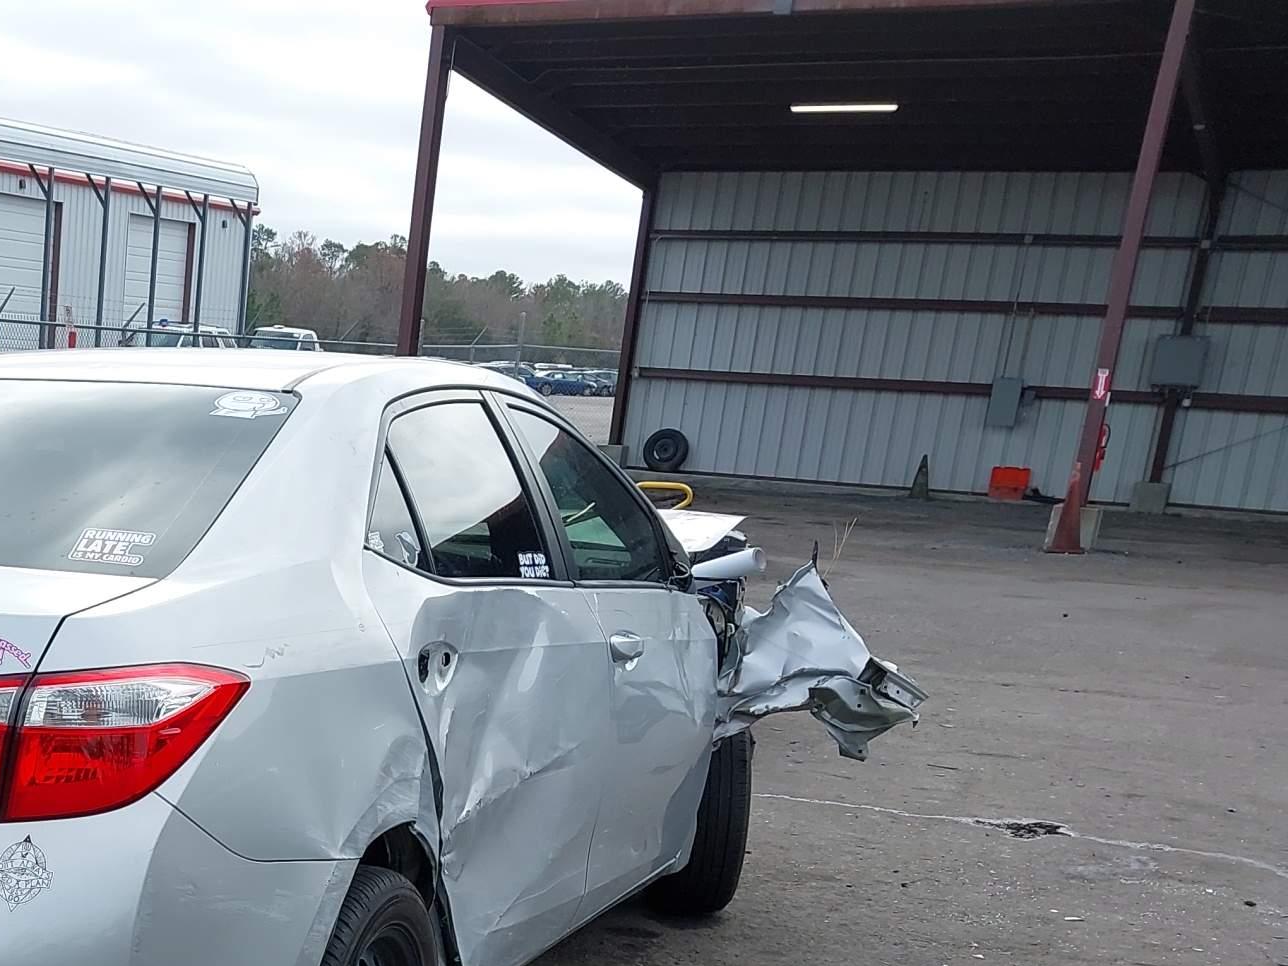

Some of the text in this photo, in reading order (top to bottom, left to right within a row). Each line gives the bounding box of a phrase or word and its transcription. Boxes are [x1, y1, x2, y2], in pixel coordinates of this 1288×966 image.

[84, 530, 152, 544] RUNNING
[77, 539, 130, 555] LATE
[85, 552, 102, 560] MY
[102, 554, 140, 564] CARDIO
[518, 553, 546, 565] BUT DID
[519, 566, 535, 578] YOU
